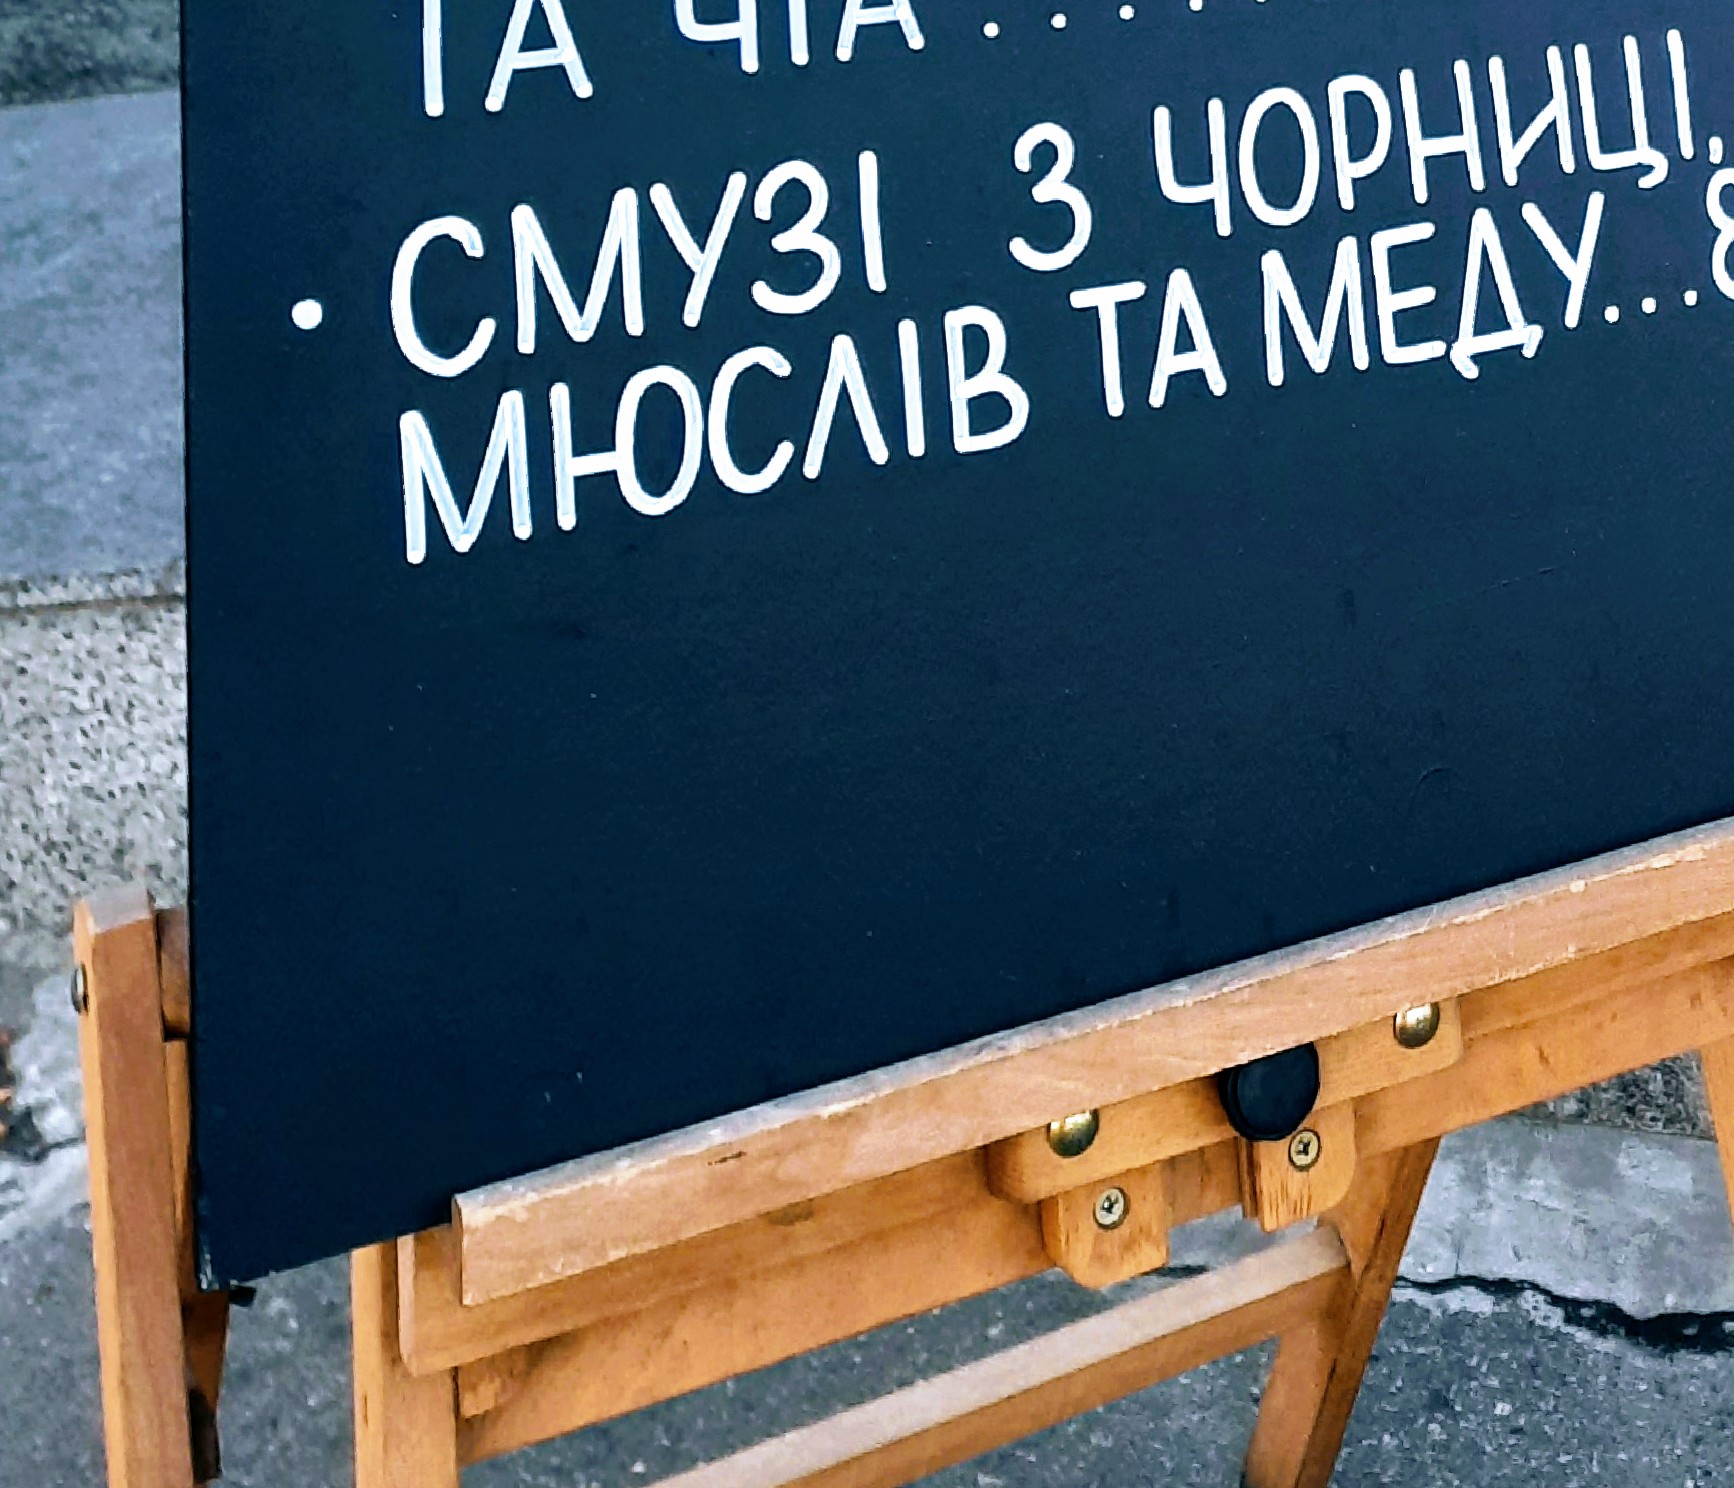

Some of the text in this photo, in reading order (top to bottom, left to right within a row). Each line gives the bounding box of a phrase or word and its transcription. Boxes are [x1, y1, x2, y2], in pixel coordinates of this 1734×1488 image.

[389, 149, 888, 379] СМУЗІ
[1152, 27, 1725, 238] ЧОРНИЦІ,
[398, 304, 1031, 566] МЮСЛІВ
[1068, 267, 1228, 419] ТА
